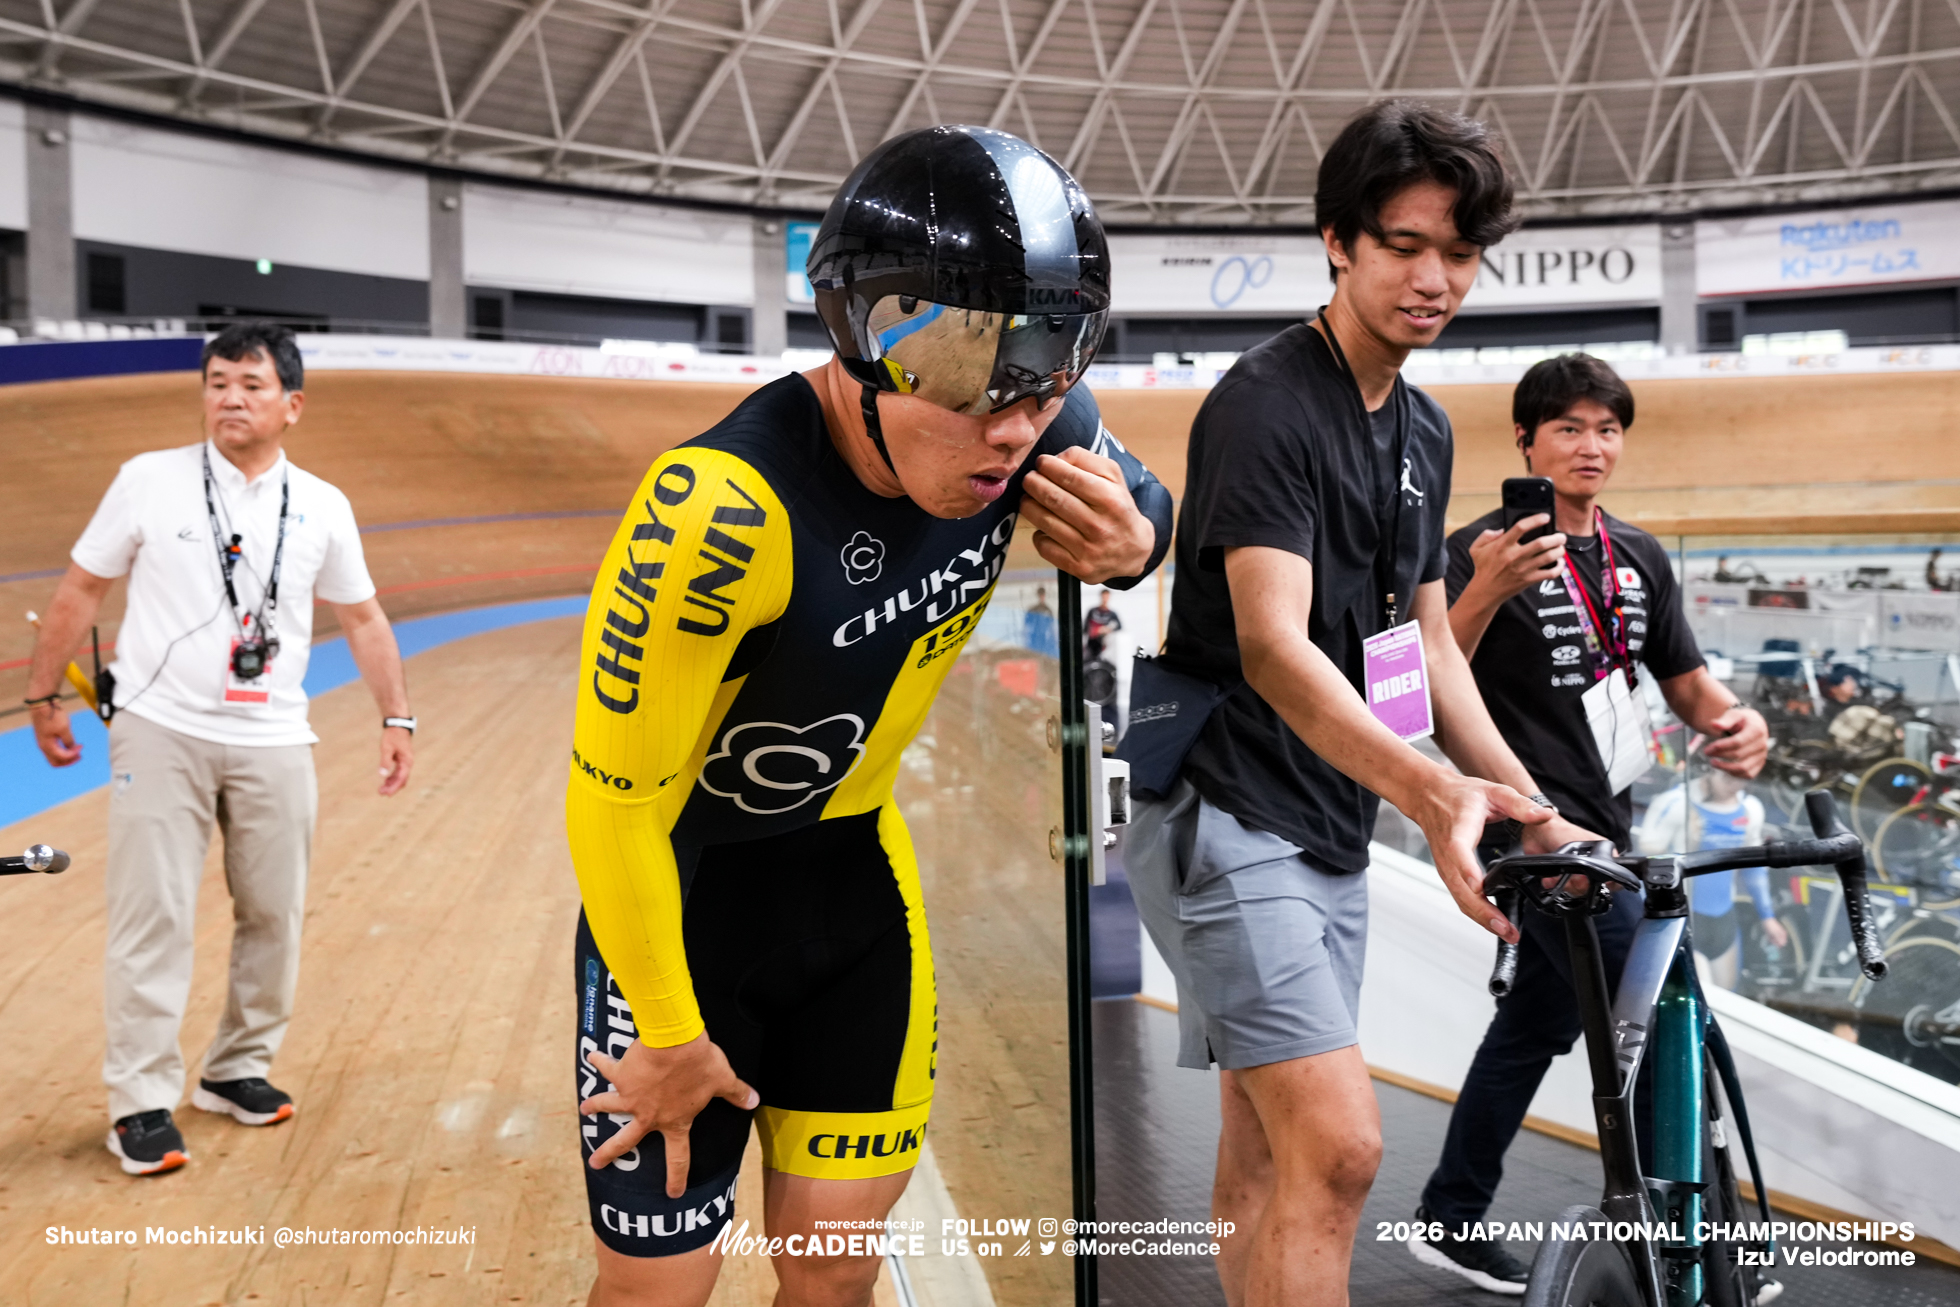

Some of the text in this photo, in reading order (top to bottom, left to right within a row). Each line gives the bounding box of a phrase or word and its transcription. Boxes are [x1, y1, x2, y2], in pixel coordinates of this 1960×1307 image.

[1475, 246, 1635, 289] NIPPO
[1780, 218, 1902, 252] Rakuten
[593, 463, 697, 715] CHUKYO
[676, 477, 767, 637] UNIV
[832, 511, 1026, 648] CHUKYO
[1372, 669, 1423, 704] RIDER
